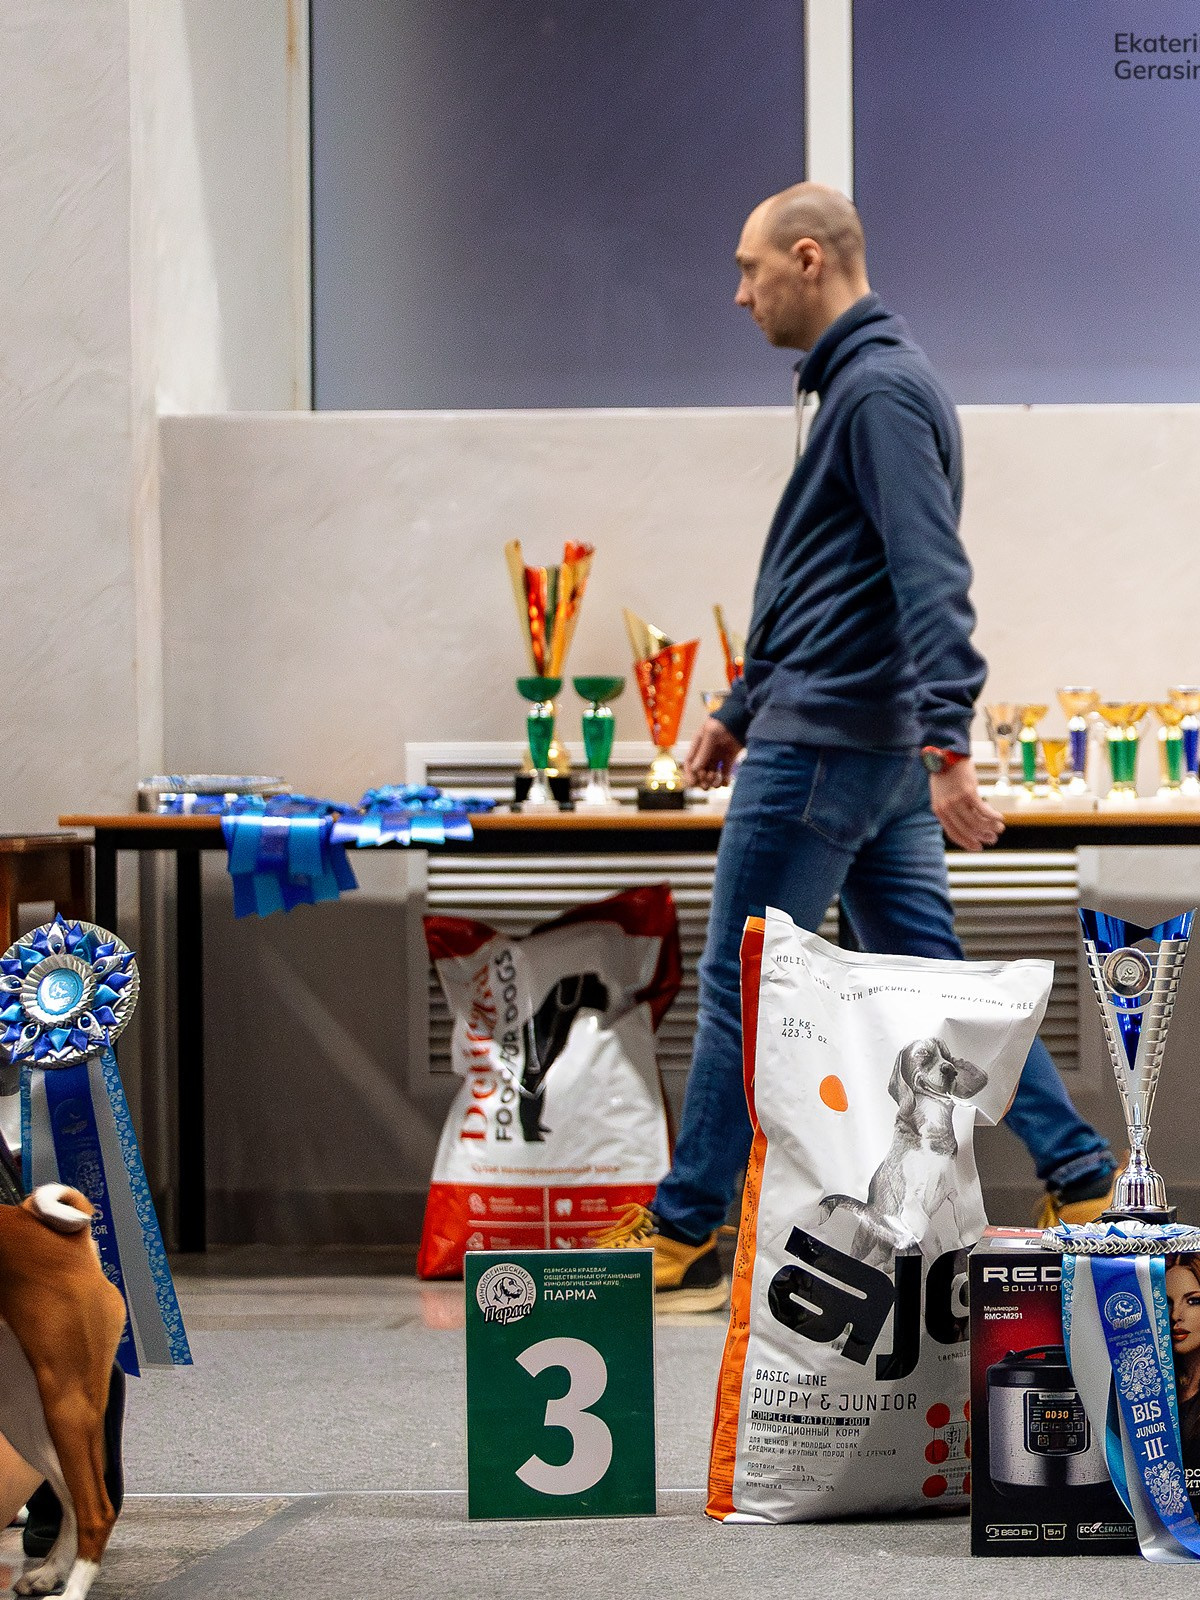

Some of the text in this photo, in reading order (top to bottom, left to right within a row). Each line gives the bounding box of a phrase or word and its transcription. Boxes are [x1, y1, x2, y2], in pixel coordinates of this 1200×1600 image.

[494, 950, 518, 1024] DOGS
[840, 992, 863, 1001] WITH
[782, 1017, 795, 1027] 12
[781, 1028, 828, 1044] 423.3 oz
[543, 1289, 597, 1301] ПАРМА
[484, 1304, 531, 1325] Парма
[755, 1368, 827, 1387] BASIC LINE
[753, 1387, 917, 1411] PUPPY & JUNIOR
[515, 1337, 613, 1496] 3
[752, 1410, 868, 1426] COMPLETE RATION FOOD
[1131, 1399, 1162, 1424] BIS
[750, 1422, 860, 1437] ПОЛНОРАЦИОННЫЙ КОРМ
[1136, 1421, 1167, 1438] JUNIOR
[748, 1444, 776, 1454] СРЕДНИХ
[822, 1450, 845, 1458] ПОРОД
[764, 1438, 789, 1447] ЩЕНКОВ
[800, 1441, 832, 1450] МОЛОДЫХ
